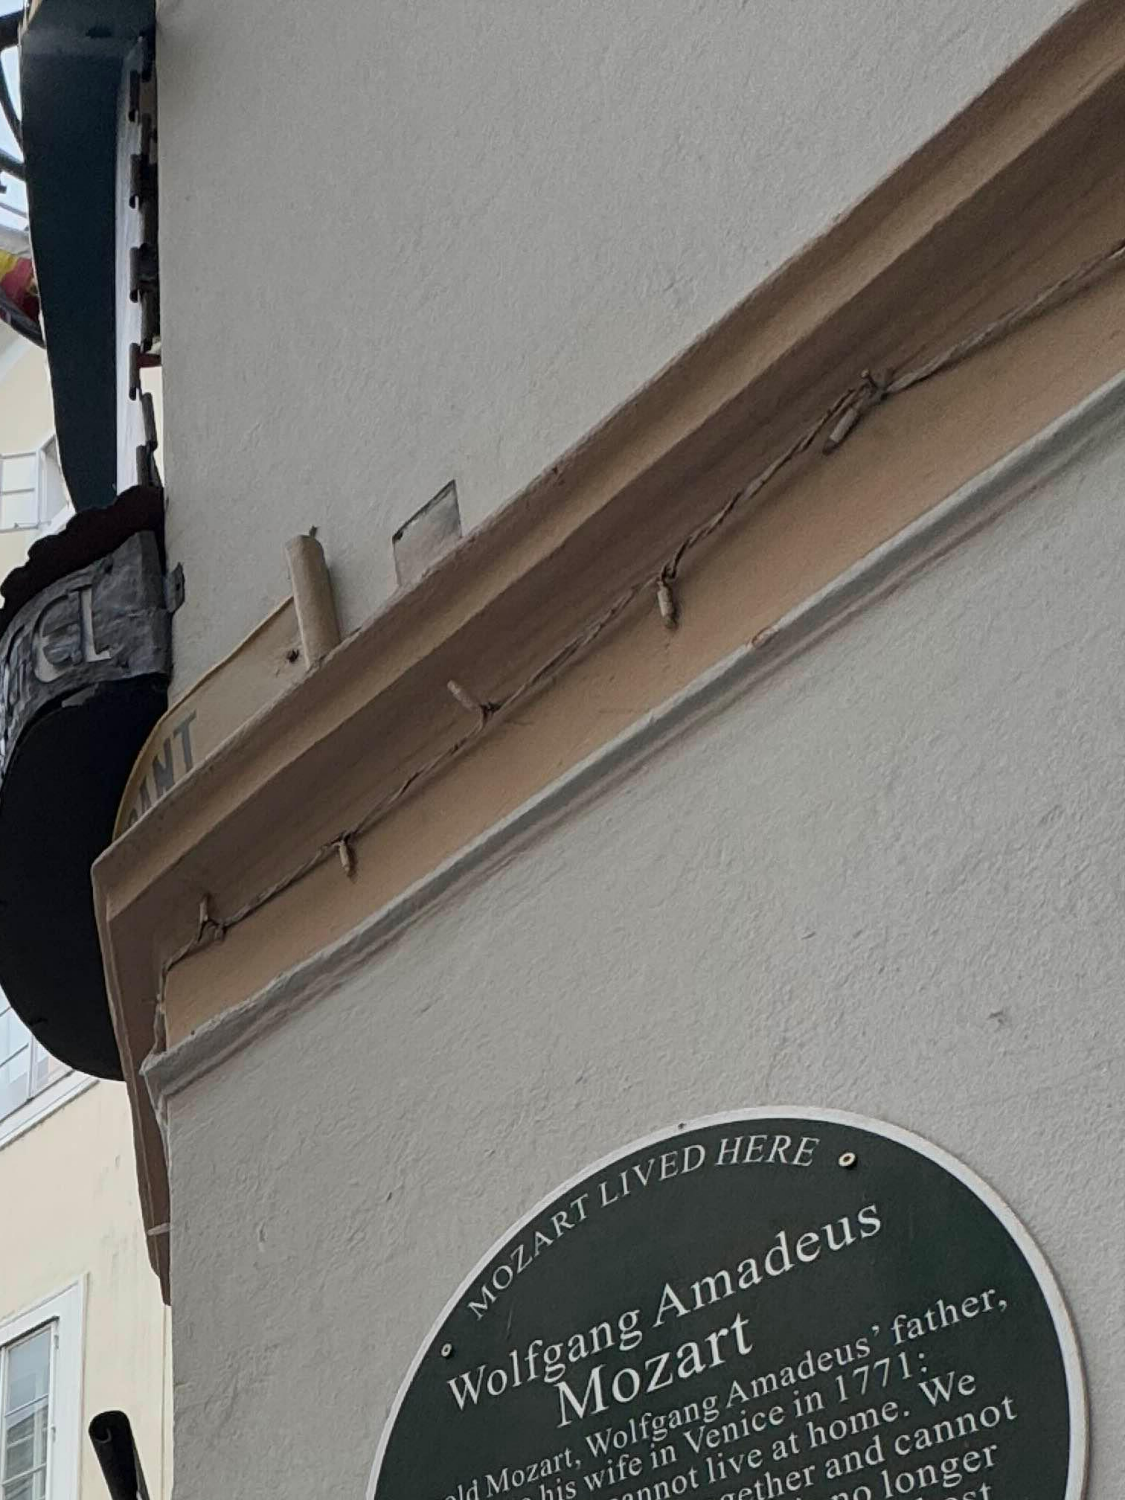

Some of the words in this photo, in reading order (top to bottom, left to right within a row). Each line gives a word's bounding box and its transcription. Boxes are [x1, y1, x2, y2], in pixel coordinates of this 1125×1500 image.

[467, 1193, 588, 1320] MOZART
[599, 1144, 706, 1208] LIVED
[714, 1134, 820, 1166] HERE
[446, 1309, 643, 1410] Wolfgang
[652, 1204, 881, 1328] Amadeus
[553, 1312, 753, 1428] Mozart
[485, 1447, 581, 1498] Mozart,
[585, 1395, 720, 1457] Wolfgang
[726, 1325, 880, 1409] Amadeus’
[890, 1289, 1007, 1345] father,
[583, 1454, 642, 1491] wife
[650, 1443, 677, 1470] in
[683, 1406, 785, 1453] Venice
[793, 1390, 825, 1418] in
[835, 1352, 927, 1402] 1771:
[706, 1449, 763, 1484] live
[772, 1432, 800, 1461] at
[806, 1401, 910, 1448] home.
[918, 1371, 976, 1407] We
[825, 1434, 885, 1479] and
[894, 1396, 1017, 1455] cannot
[881, 1444, 997, 1499] longer
